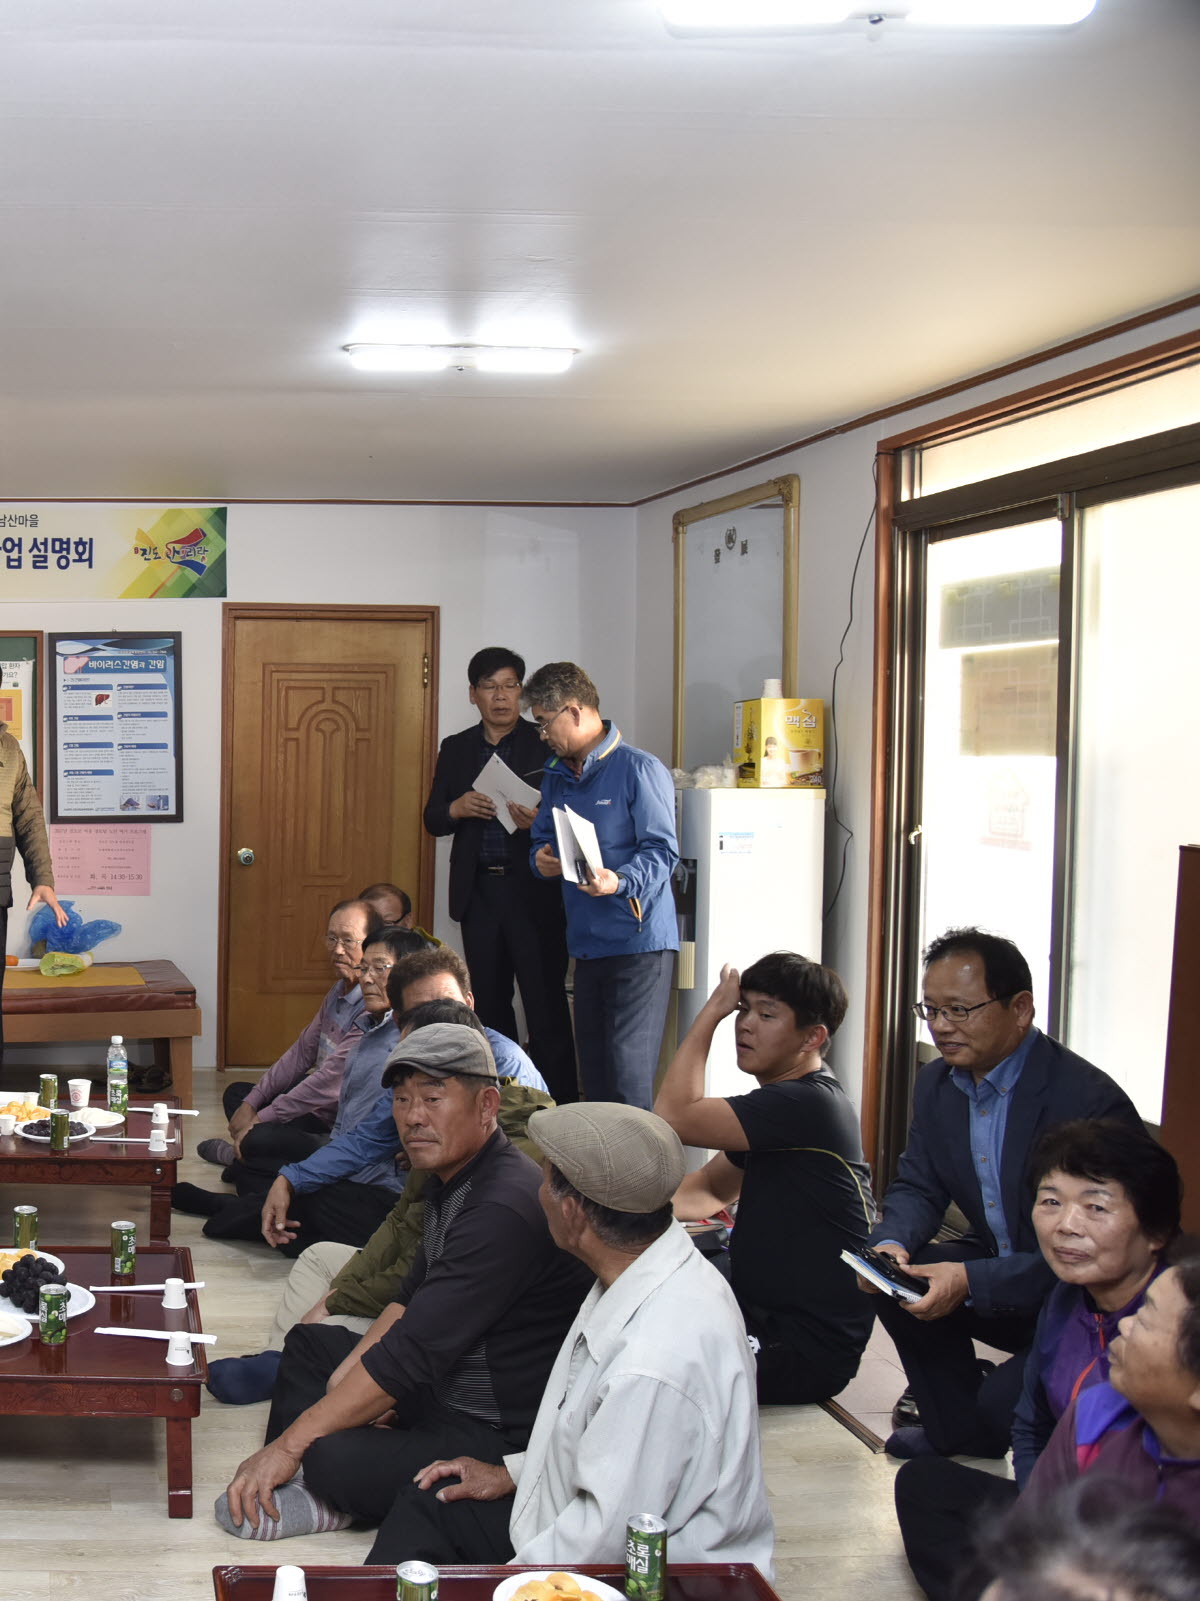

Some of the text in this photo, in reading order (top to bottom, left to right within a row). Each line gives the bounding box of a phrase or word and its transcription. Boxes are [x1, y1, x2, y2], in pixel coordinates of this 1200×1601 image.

[28, 536, 94, 570] 설명회
[785, 711, 817, 728] 맥심
[627, 1539, 650, 1557] 초록
[626, 1553, 649, 1574] 매실
